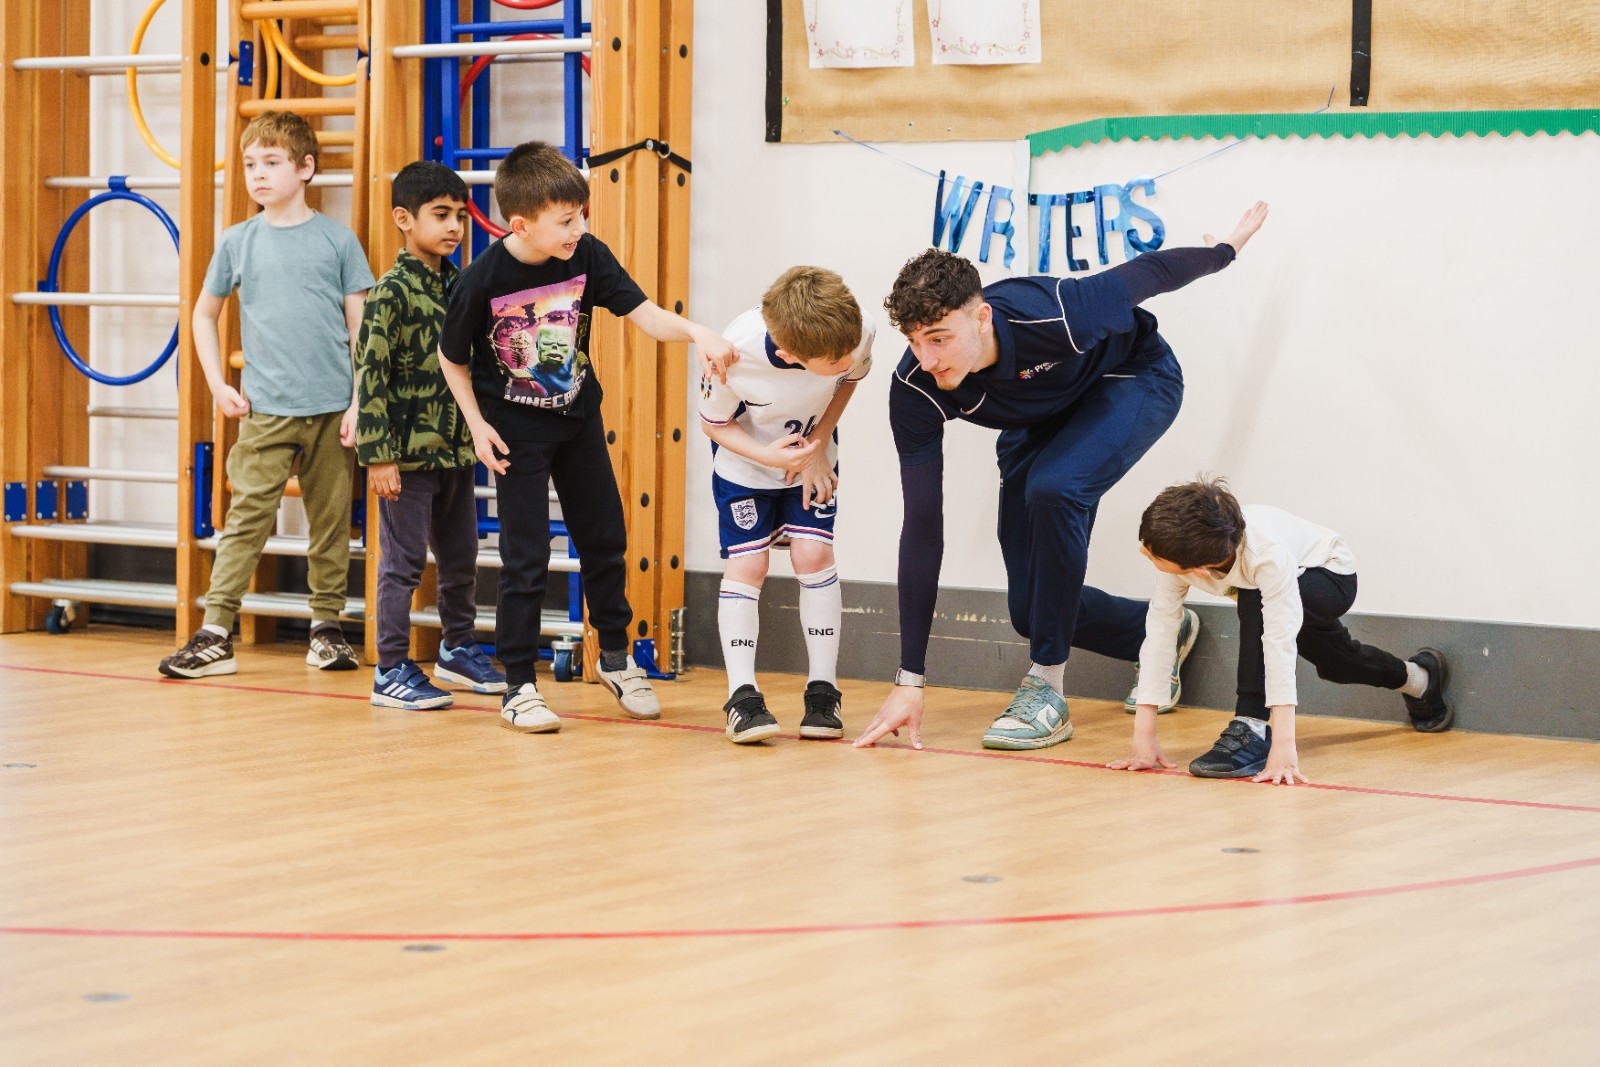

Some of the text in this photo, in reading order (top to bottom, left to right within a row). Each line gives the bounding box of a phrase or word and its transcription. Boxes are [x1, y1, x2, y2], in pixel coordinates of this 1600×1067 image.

[932, 169, 1166, 273] WRTERS
[807, 627, 834, 636] ENG
[730, 638, 755, 648] ENG
